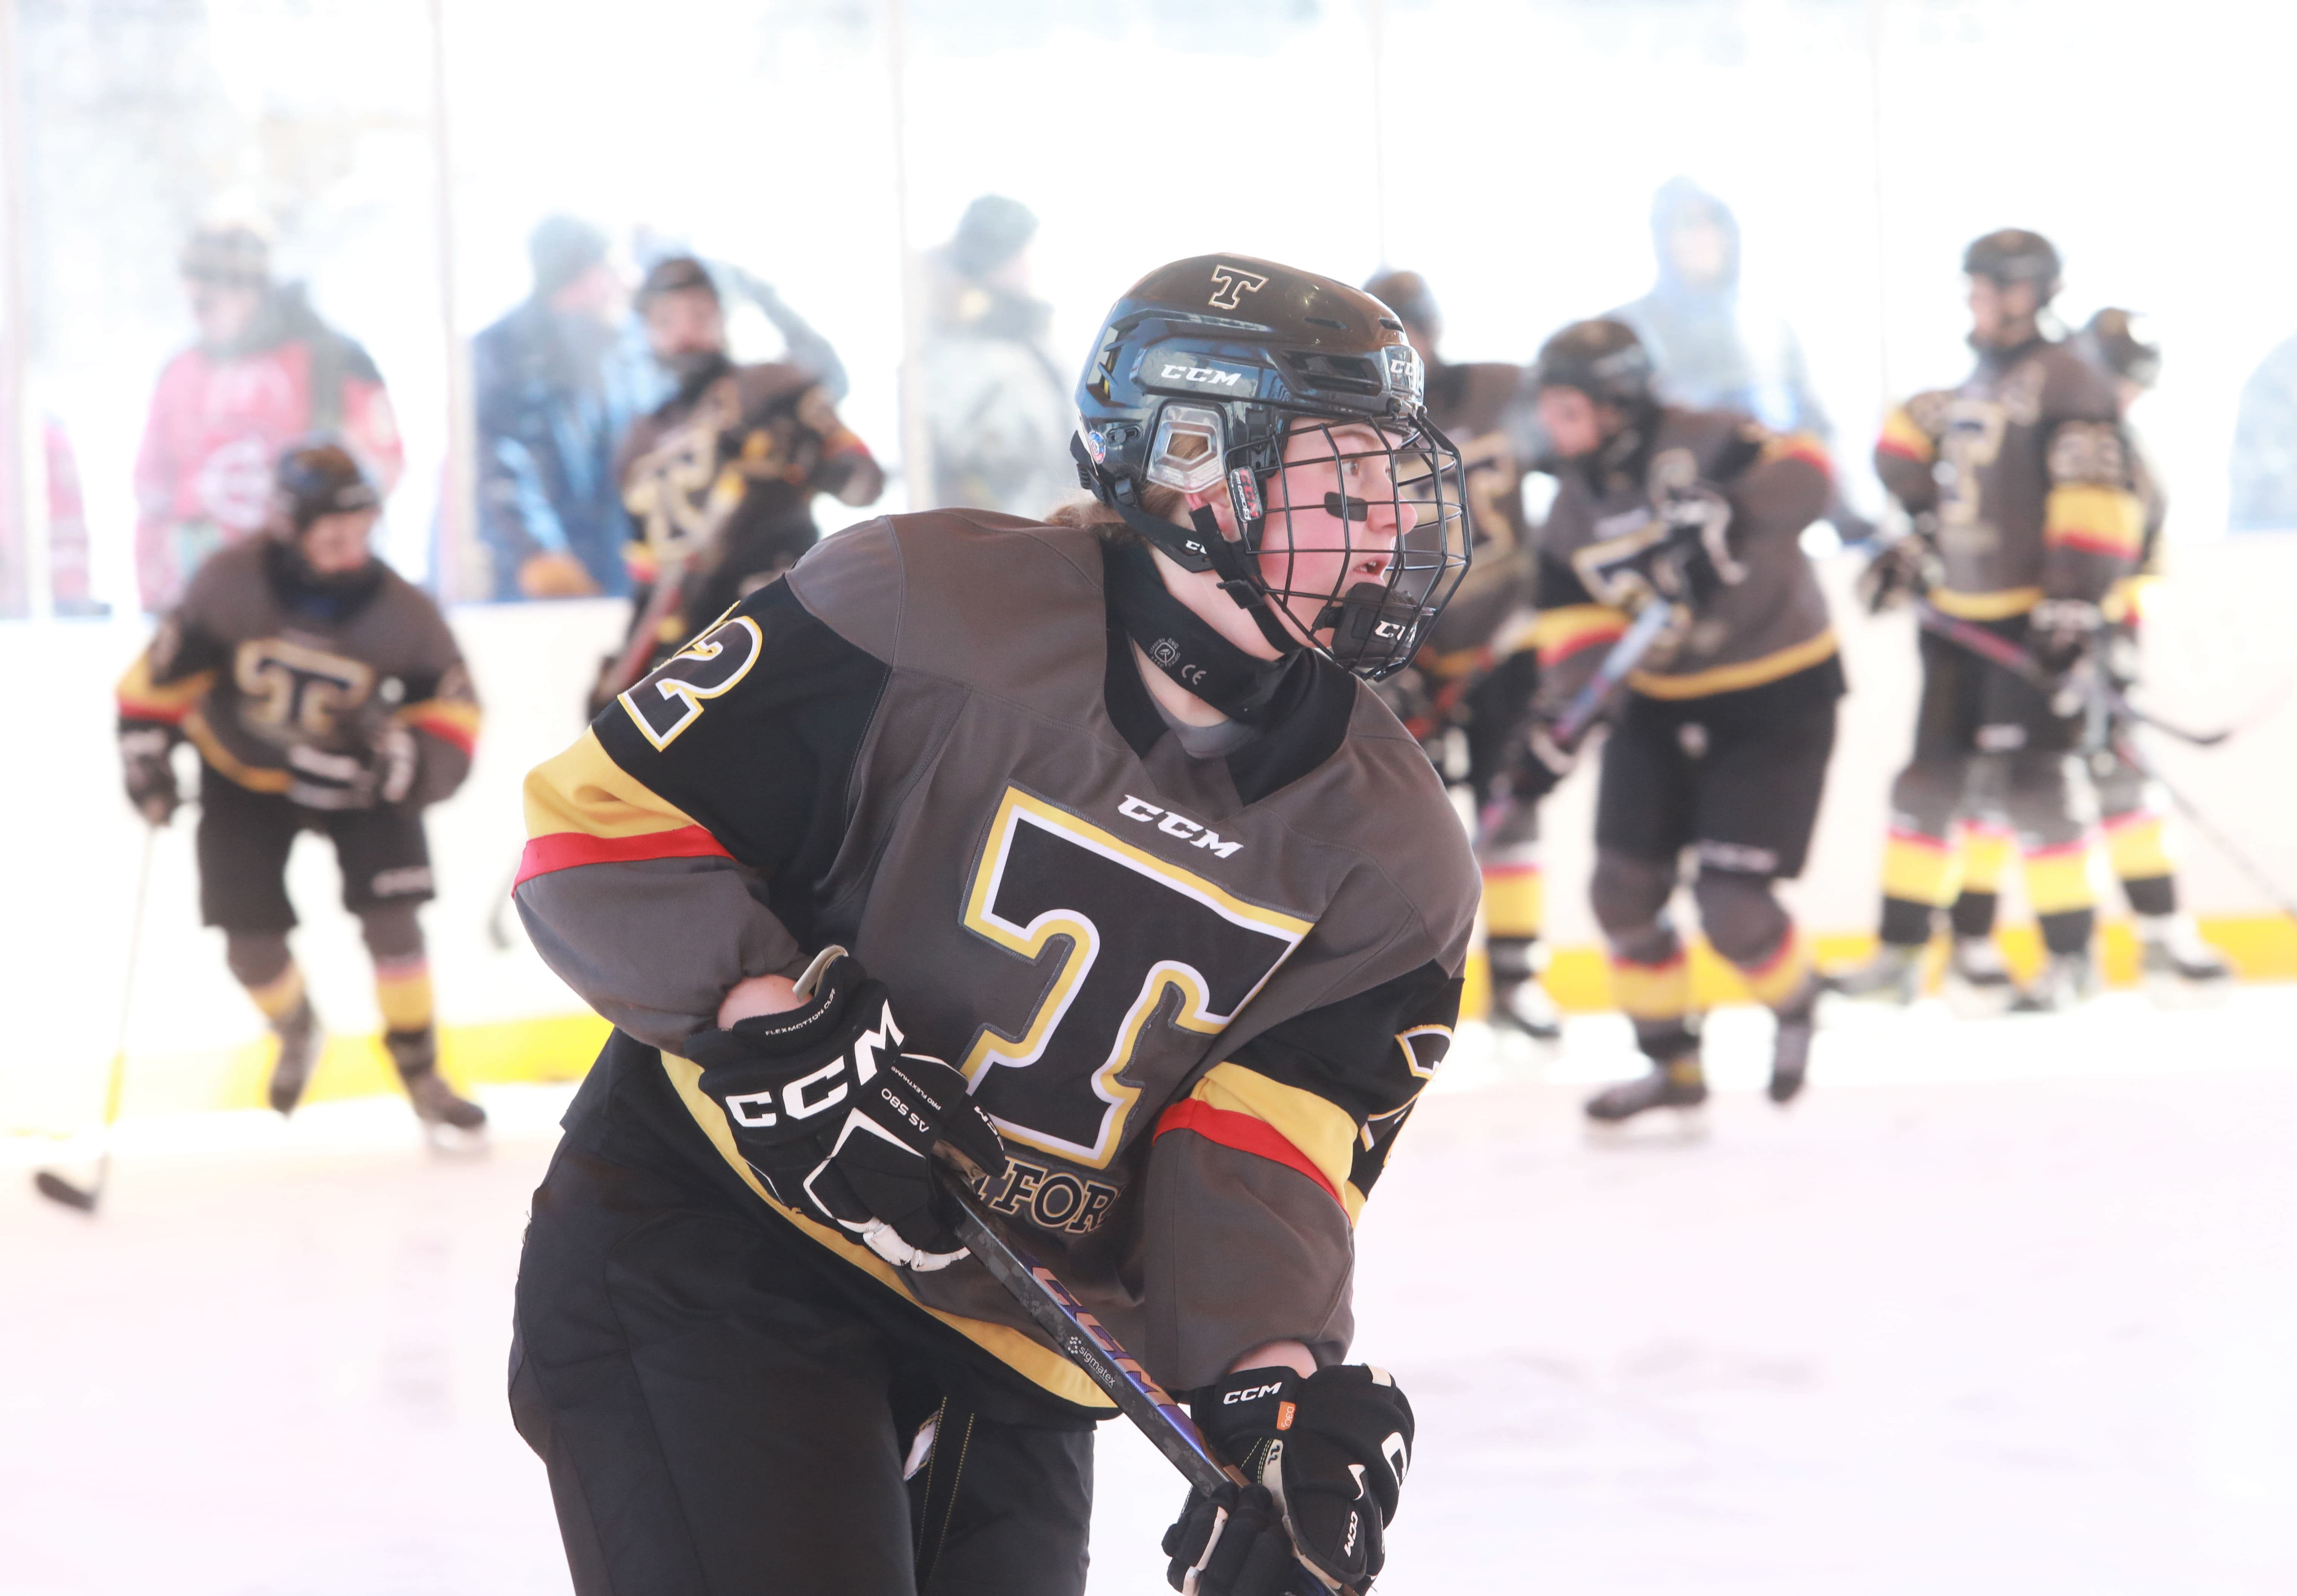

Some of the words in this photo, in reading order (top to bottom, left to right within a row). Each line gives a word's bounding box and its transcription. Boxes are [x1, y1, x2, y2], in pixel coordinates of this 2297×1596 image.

[1208, 264, 1269, 310] T
[1161, 364, 1242, 386] CCM
[1117, 794, 1244, 858] CCM
[959, 785, 1318, 1171] T
[724, 999, 905, 1128] CCM
[881, 1088, 909, 1116] 580
[908, 1112, 930, 1133] AS
[927, 1096, 942, 1111] PRO
[1032, 1266, 1178, 1407] CCM
[1079, 1346, 1116, 1387] sigmatex
[1223, 1382, 1282, 1405] CCM
[1344, 1511, 1358, 1558] CCM
